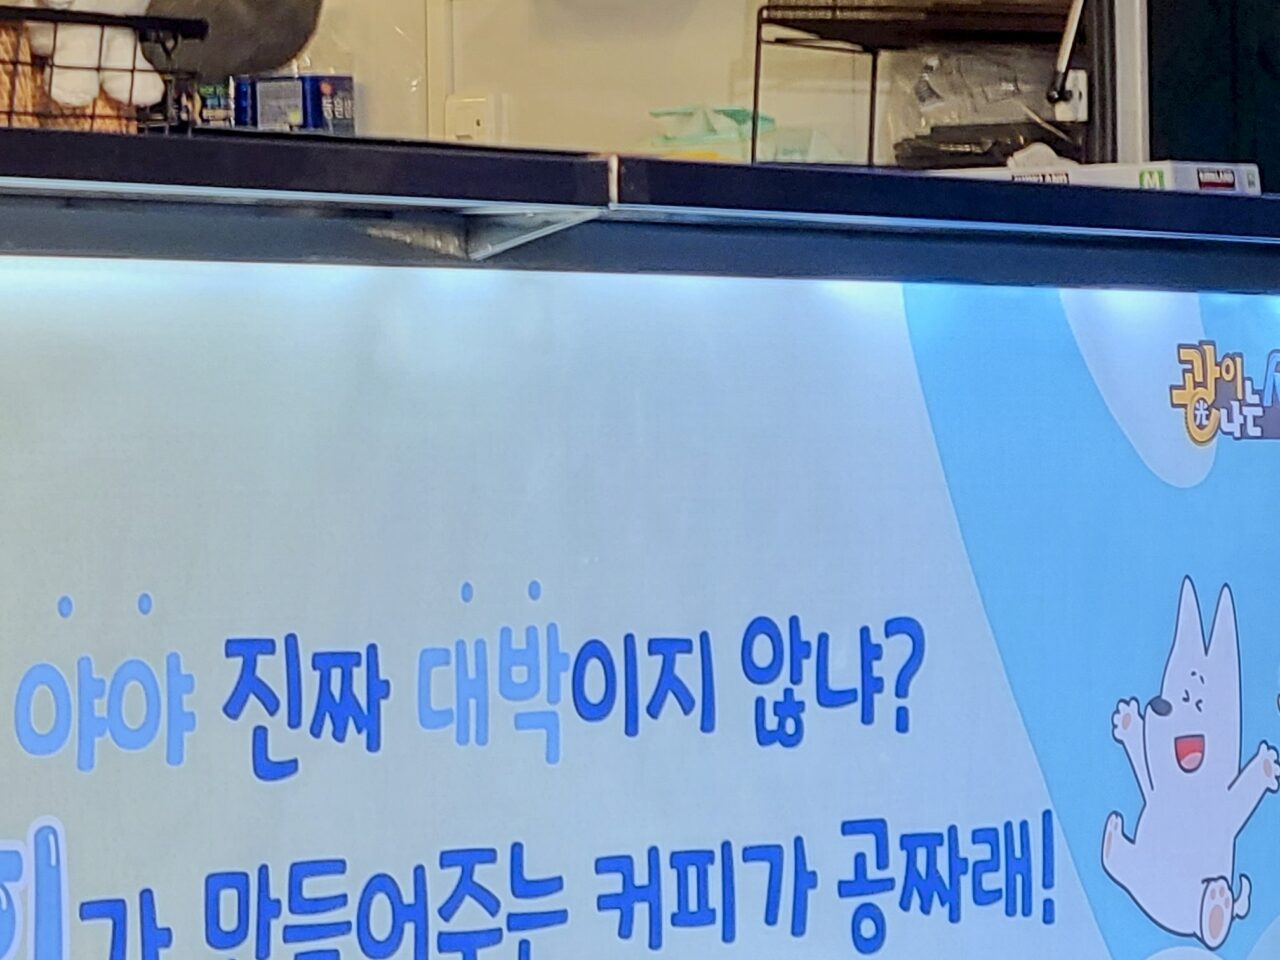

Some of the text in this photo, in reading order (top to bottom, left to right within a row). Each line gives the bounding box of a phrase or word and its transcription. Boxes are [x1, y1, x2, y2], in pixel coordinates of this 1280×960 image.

[14, 614, 926, 782] 야야 진짜 대박이지 않냐?
[594, 836, 819, 951] 커피가
[836, 808, 1057, 956] 공짜래!
